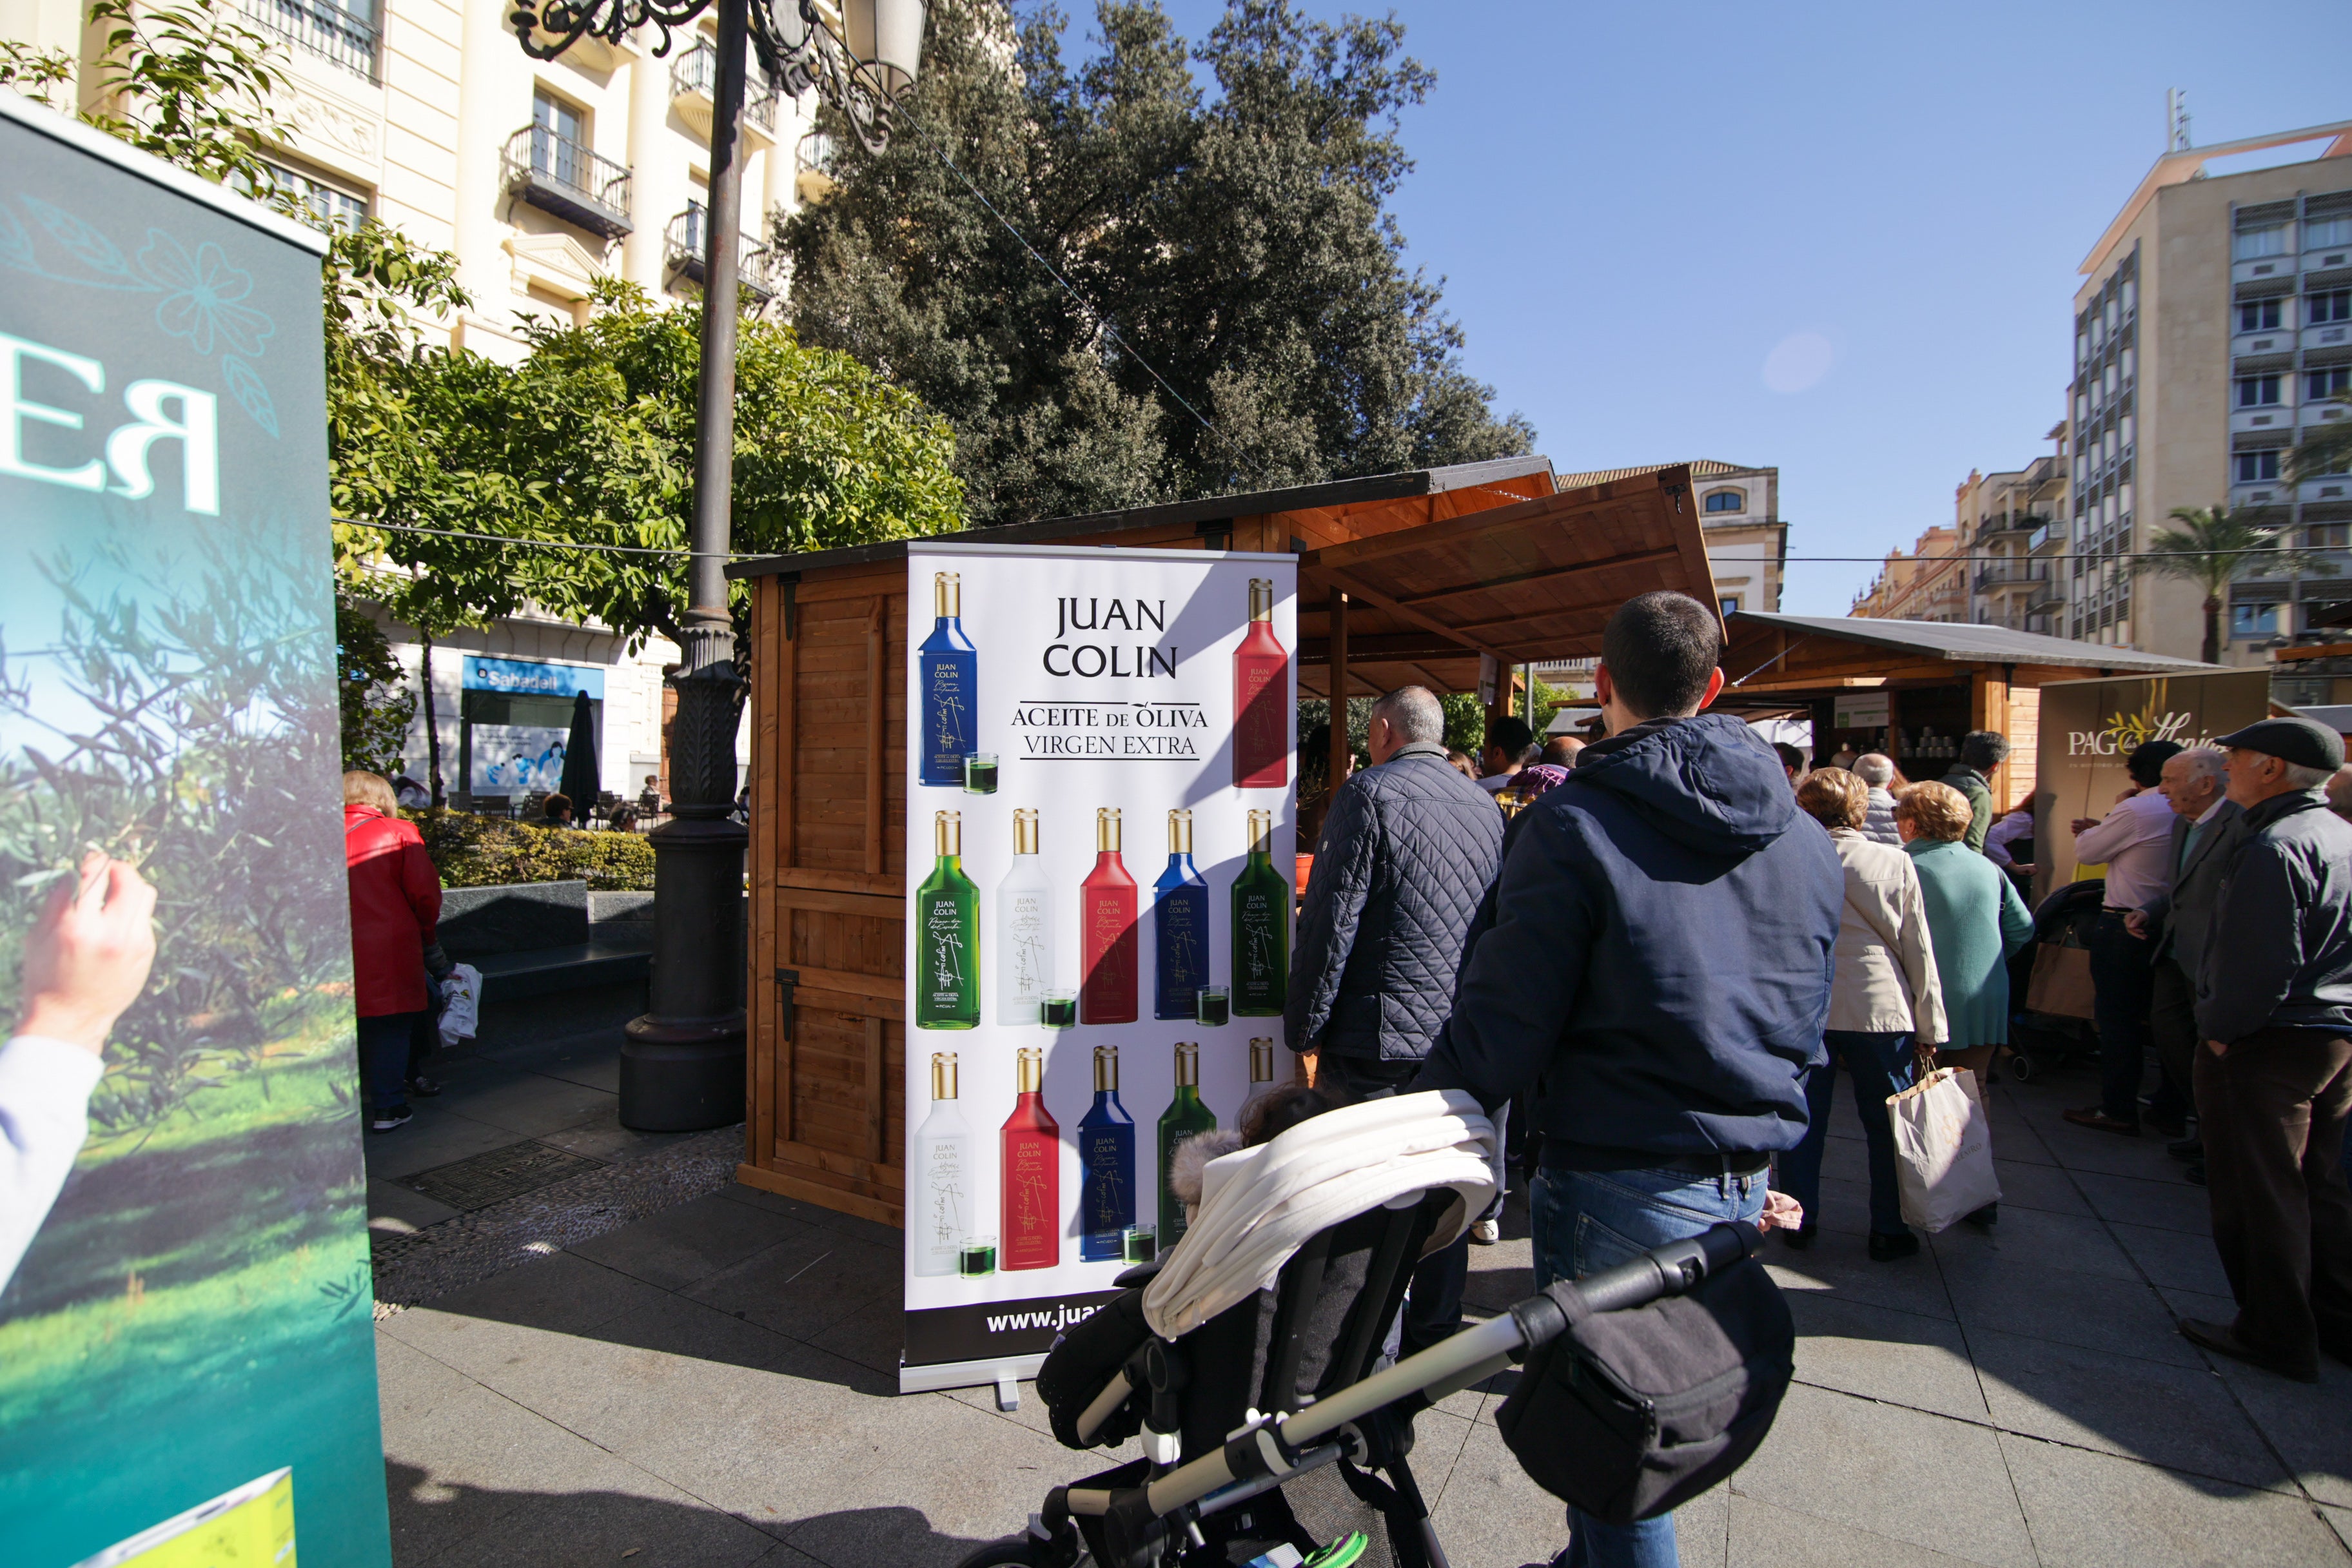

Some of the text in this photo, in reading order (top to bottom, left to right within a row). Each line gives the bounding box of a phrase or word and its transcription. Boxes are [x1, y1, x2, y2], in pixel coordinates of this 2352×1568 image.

[1055, 597, 1166, 640] JUAN
[1043, 644, 1179, 680] COLIN
[488, 671, 557, 691] Sabadell
[1011, 707, 1209, 728] ACEITE DE OLIVA
[1025, 736, 1197, 756] VIRGEN EXTRA
[936, 901, 955, 909] JUAN
[1095, 1137, 1114, 1146] JUAN
[1175, 1129, 1193, 1137] JUAN
[1020, 1142, 1039, 1150] JUAN
